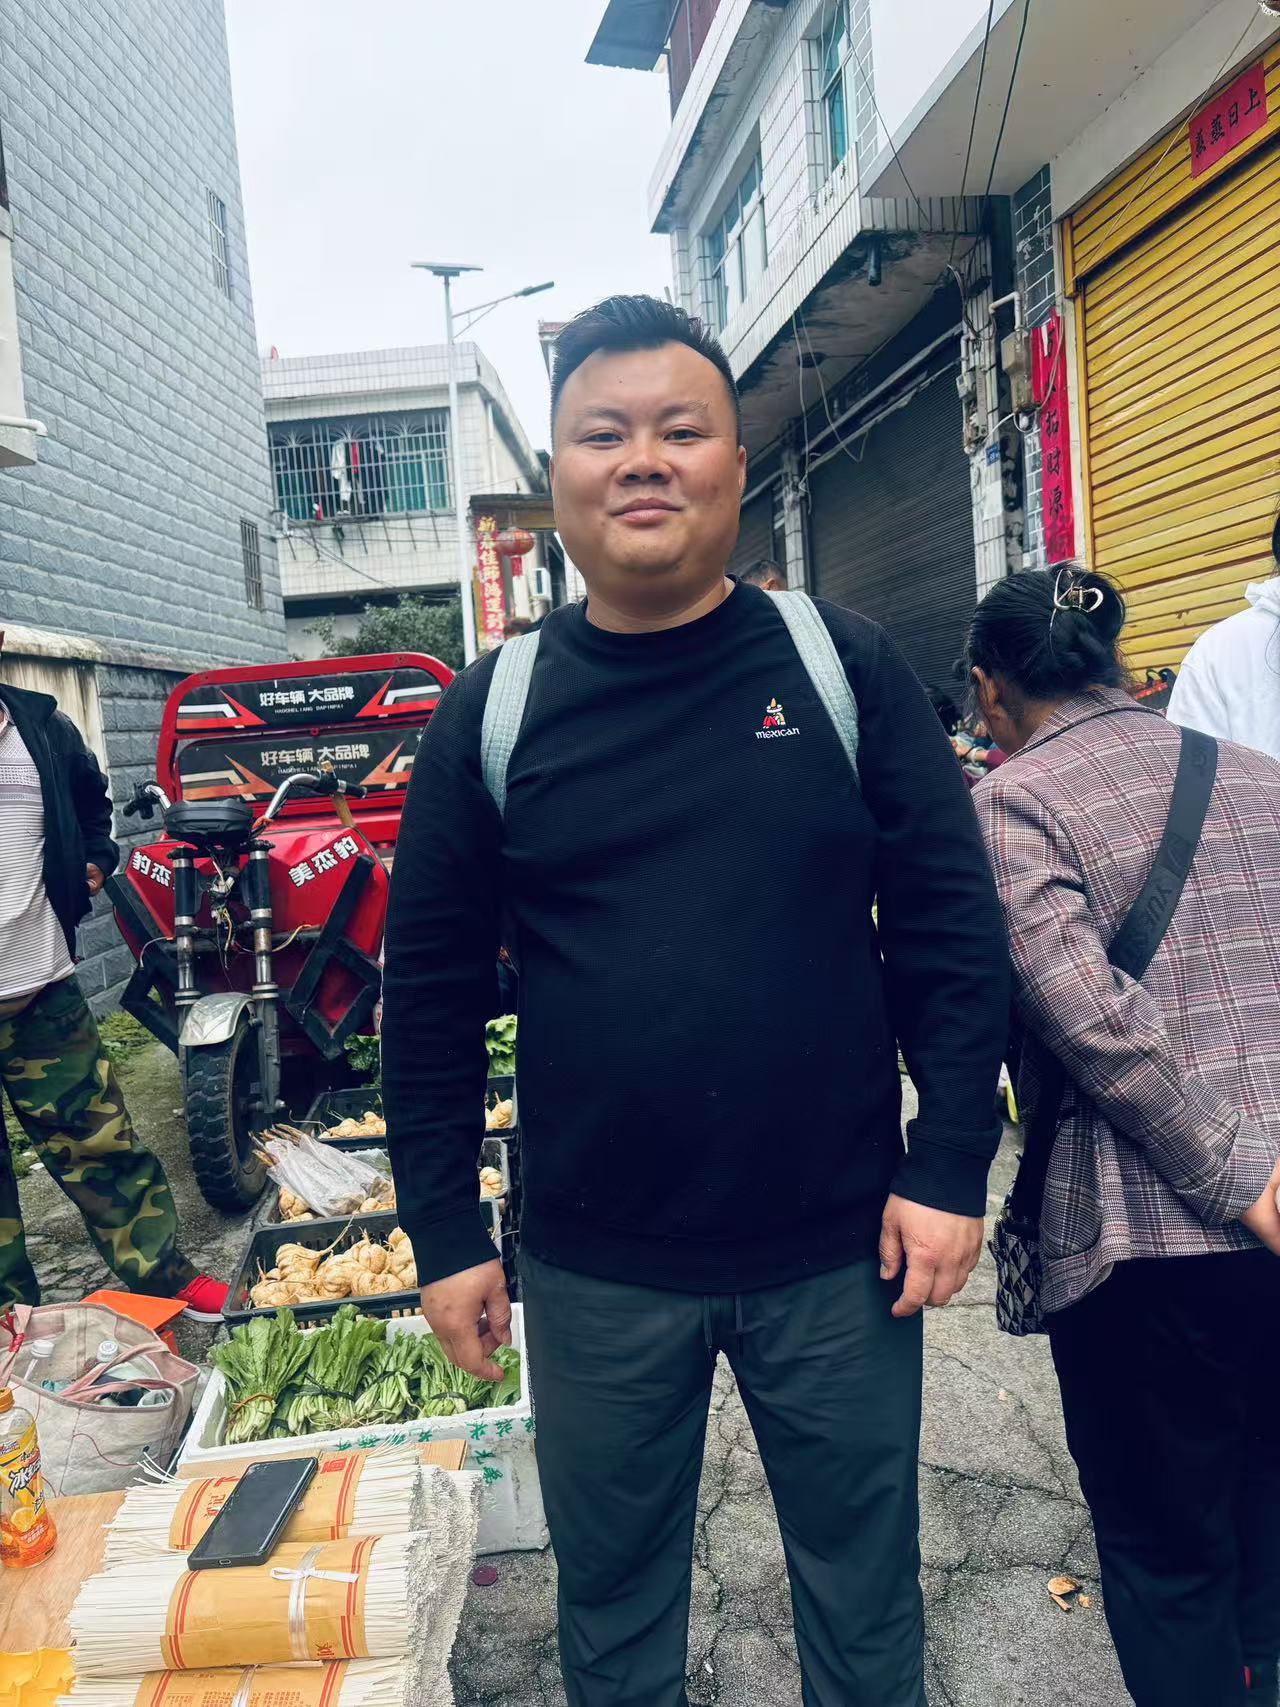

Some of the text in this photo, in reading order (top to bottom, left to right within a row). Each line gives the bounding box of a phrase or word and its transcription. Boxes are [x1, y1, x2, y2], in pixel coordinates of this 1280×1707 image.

[260, 686, 355, 707] 好车辆 大品牌
[261, 743, 371, 767] 好车辆 大品牌
[132, 851, 174, 888] 豹杰
[288, 835, 359, 888] 美杰豹
